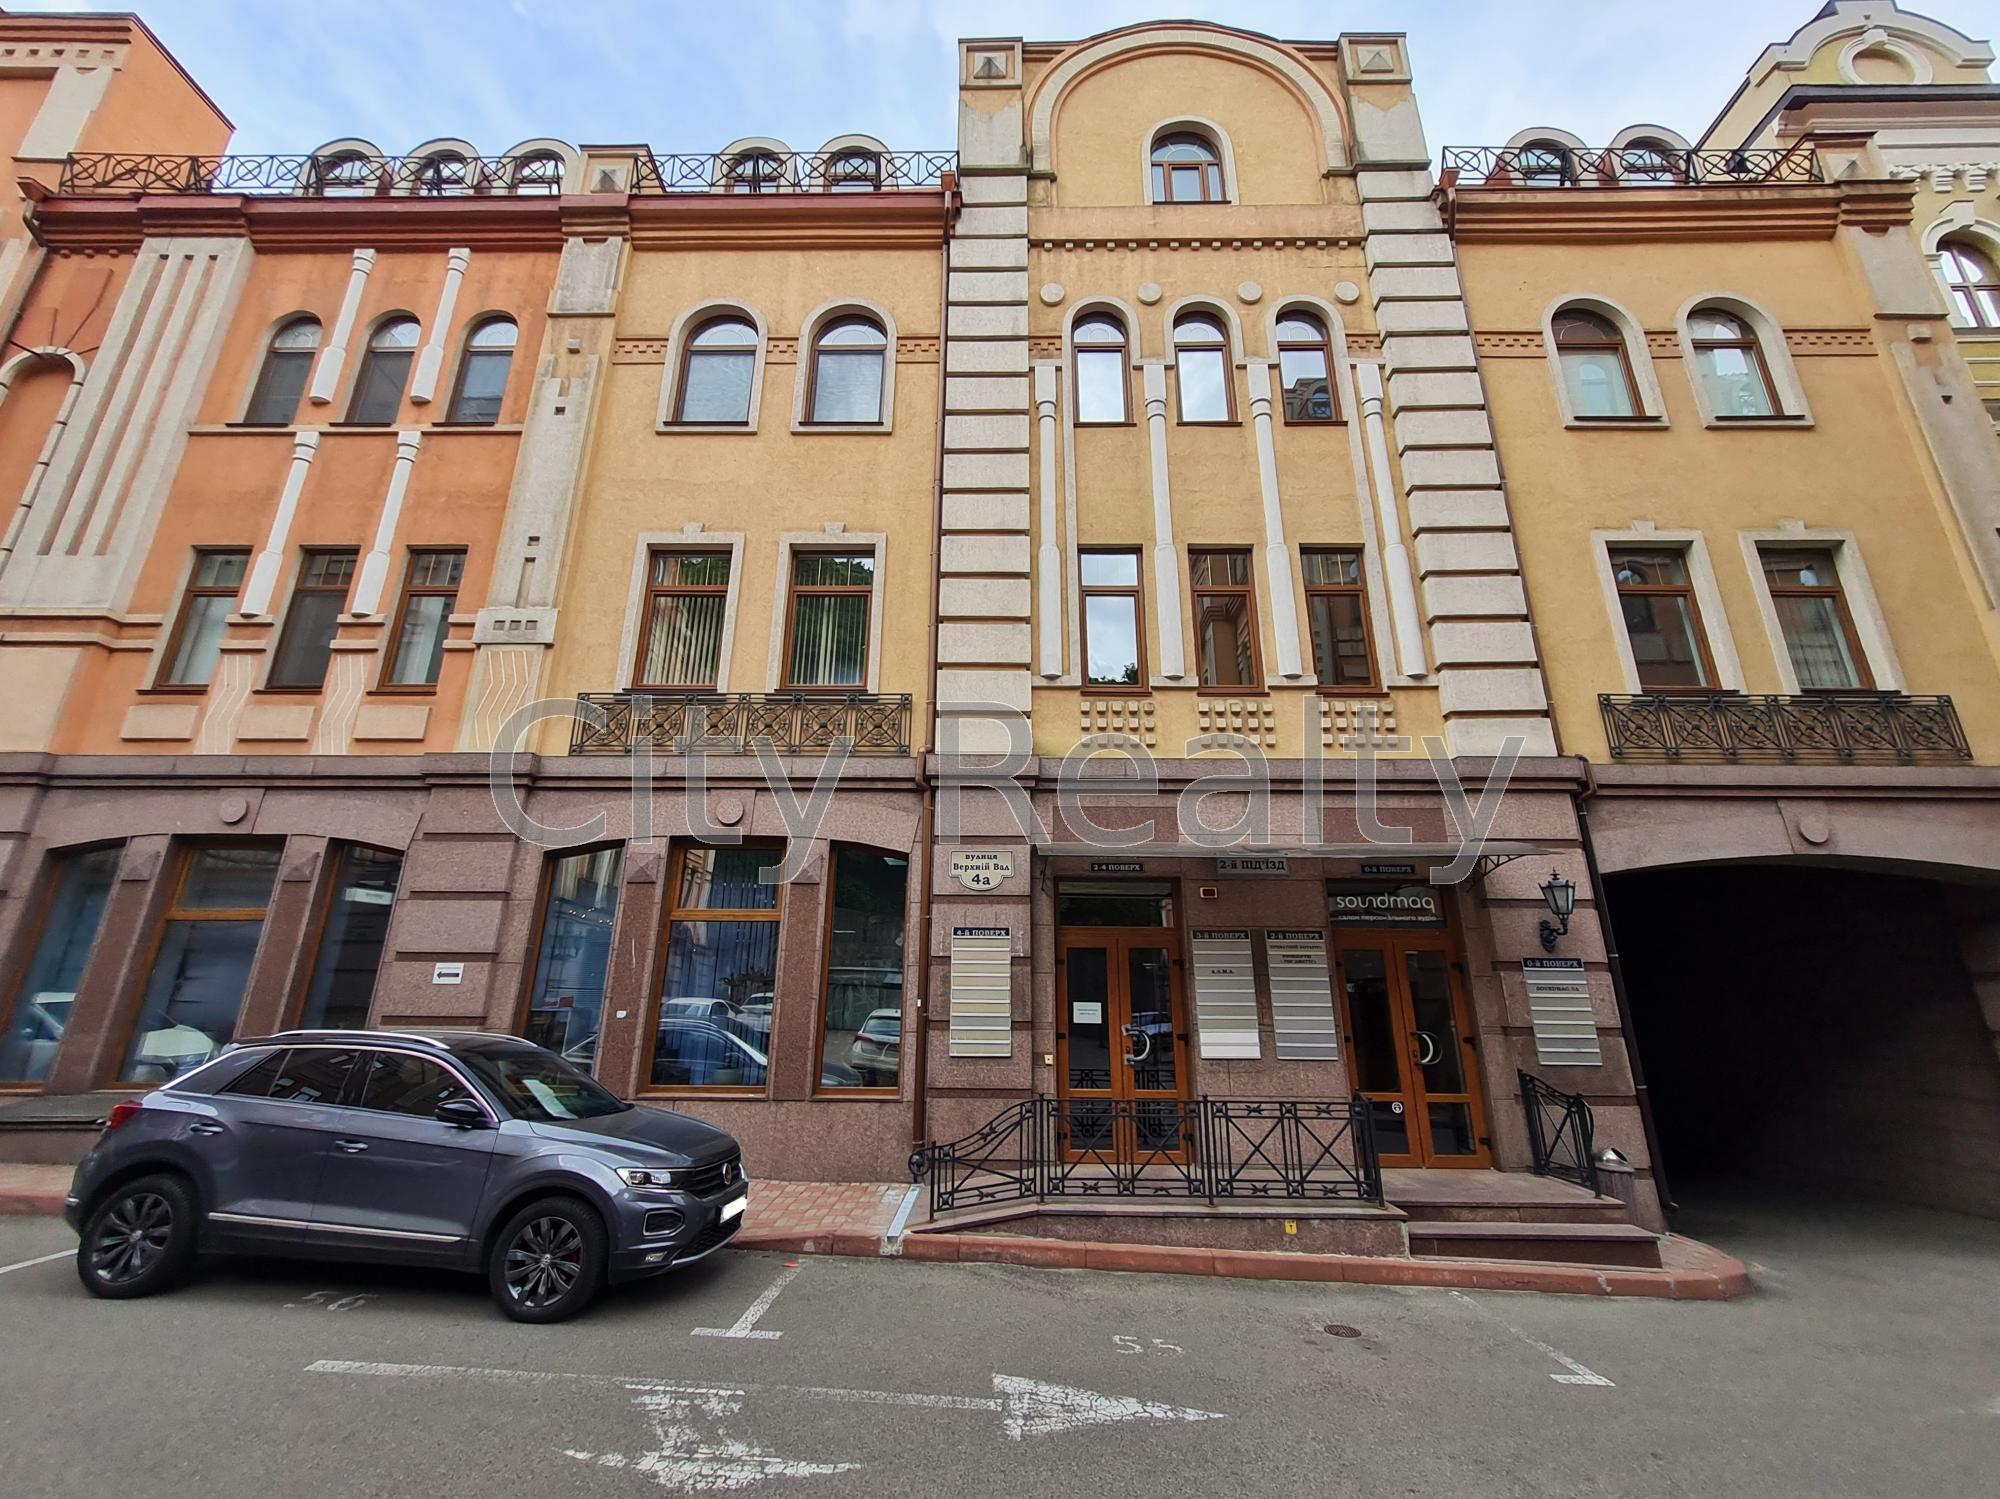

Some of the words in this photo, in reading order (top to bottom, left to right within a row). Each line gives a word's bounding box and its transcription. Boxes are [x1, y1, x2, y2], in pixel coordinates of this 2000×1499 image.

[965, 853, 998, 861] вулиця
[953, 862, 990, 873] Верхній
[993, 863, 1010, 872] Вал
[1219, 859, 1238, 870] 2-й
[972, 874, 991, 885] 4а
[956, 929, 970, 937] 4-й
[972, 929, 1007, 937] ПОВЕРХ
[1211, 932, 1246, 940] ПОВЕРХ
[1285, 932, 1321, 940] ПОВЕРХ
